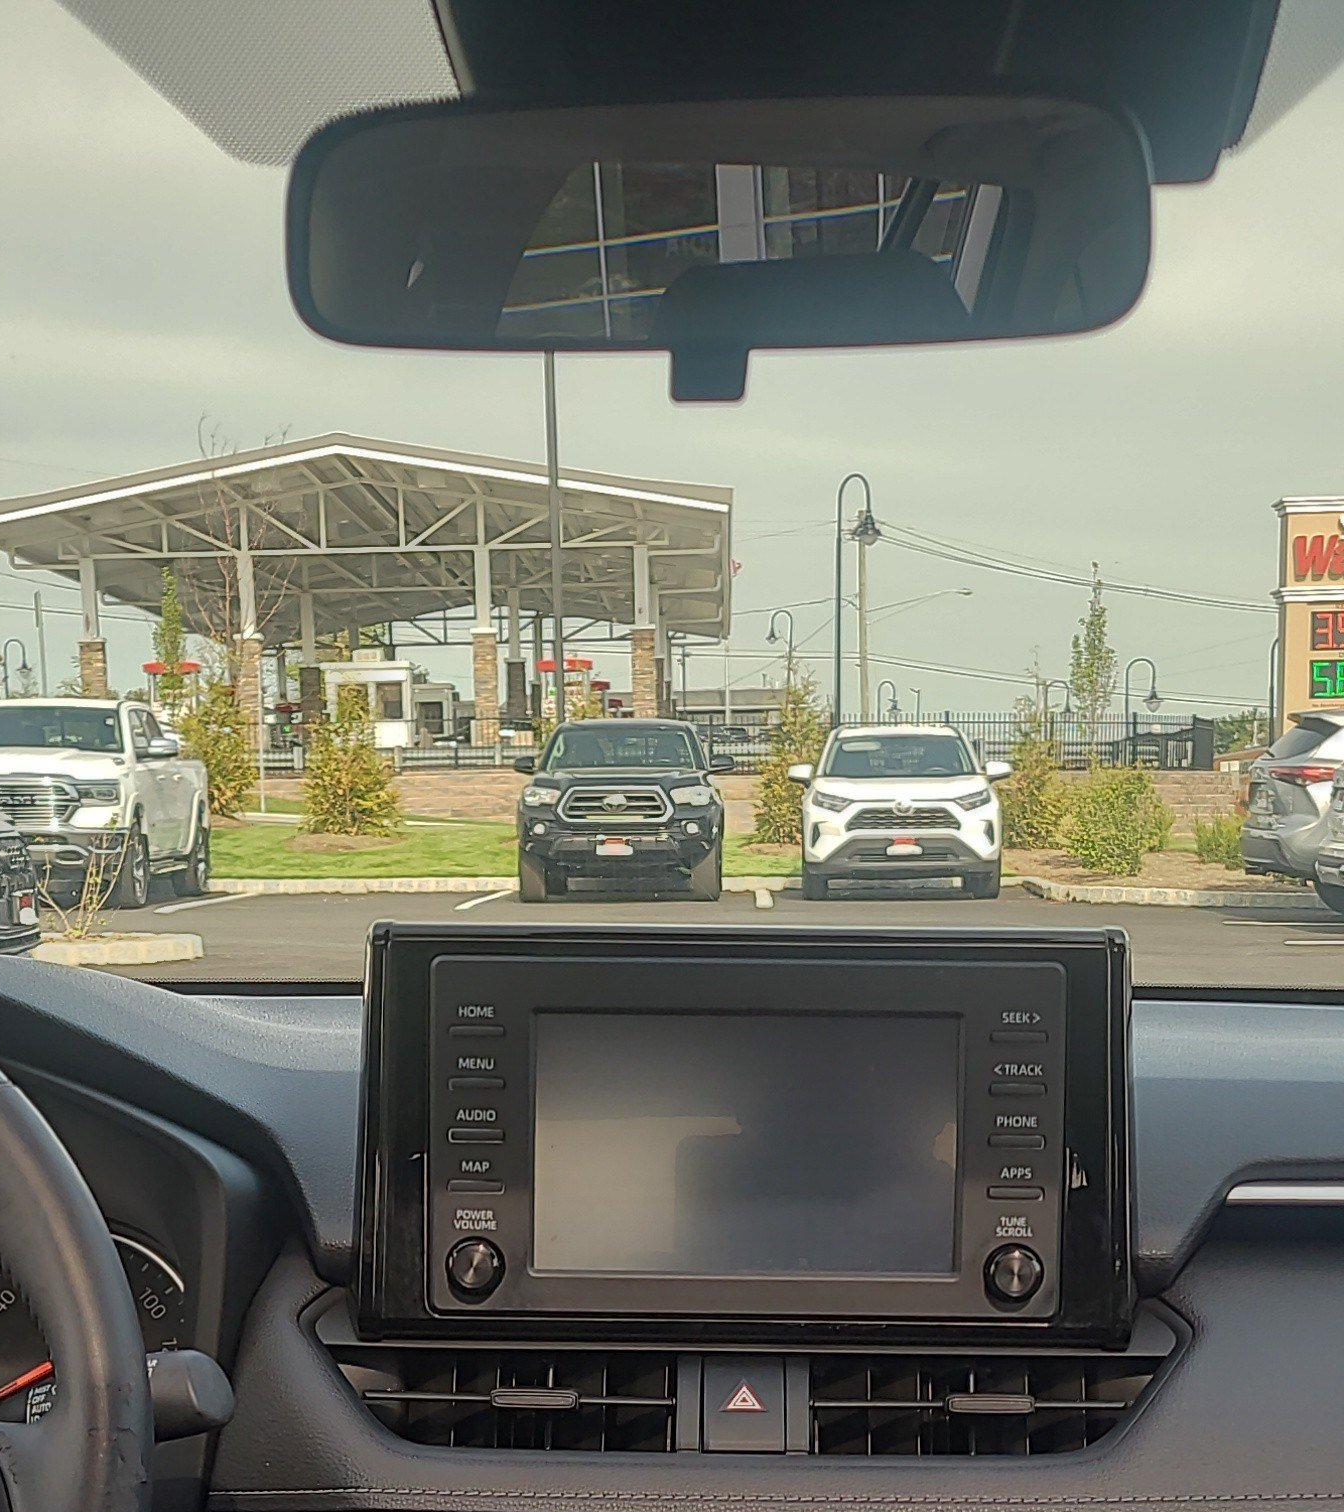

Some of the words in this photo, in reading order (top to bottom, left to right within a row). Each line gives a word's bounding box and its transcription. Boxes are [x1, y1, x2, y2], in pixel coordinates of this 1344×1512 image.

[458, 1006, 495, 1018] HOME
[457, 1057, 495, 1070] MENU
[455, 1109, 497, 1122] AUDIO
[995, 1116, 1038, 1128] PHONE
[461, 1160, 490, 1173] MAP
[1000, 1166, 1033, 1179] APPS
[456, 1209, 494, 1220] POWER
[453, 1219, 497, 1230] VOLUME
[999, 1216, 1027, 1227] TUNE
[995, 1226, 1033, 1237] SCROLL
[138, 1286, 167, 1321] 100
[31, 1394, 46, 1405] OFF
[31, 1401, 52, 1414] AUTO
